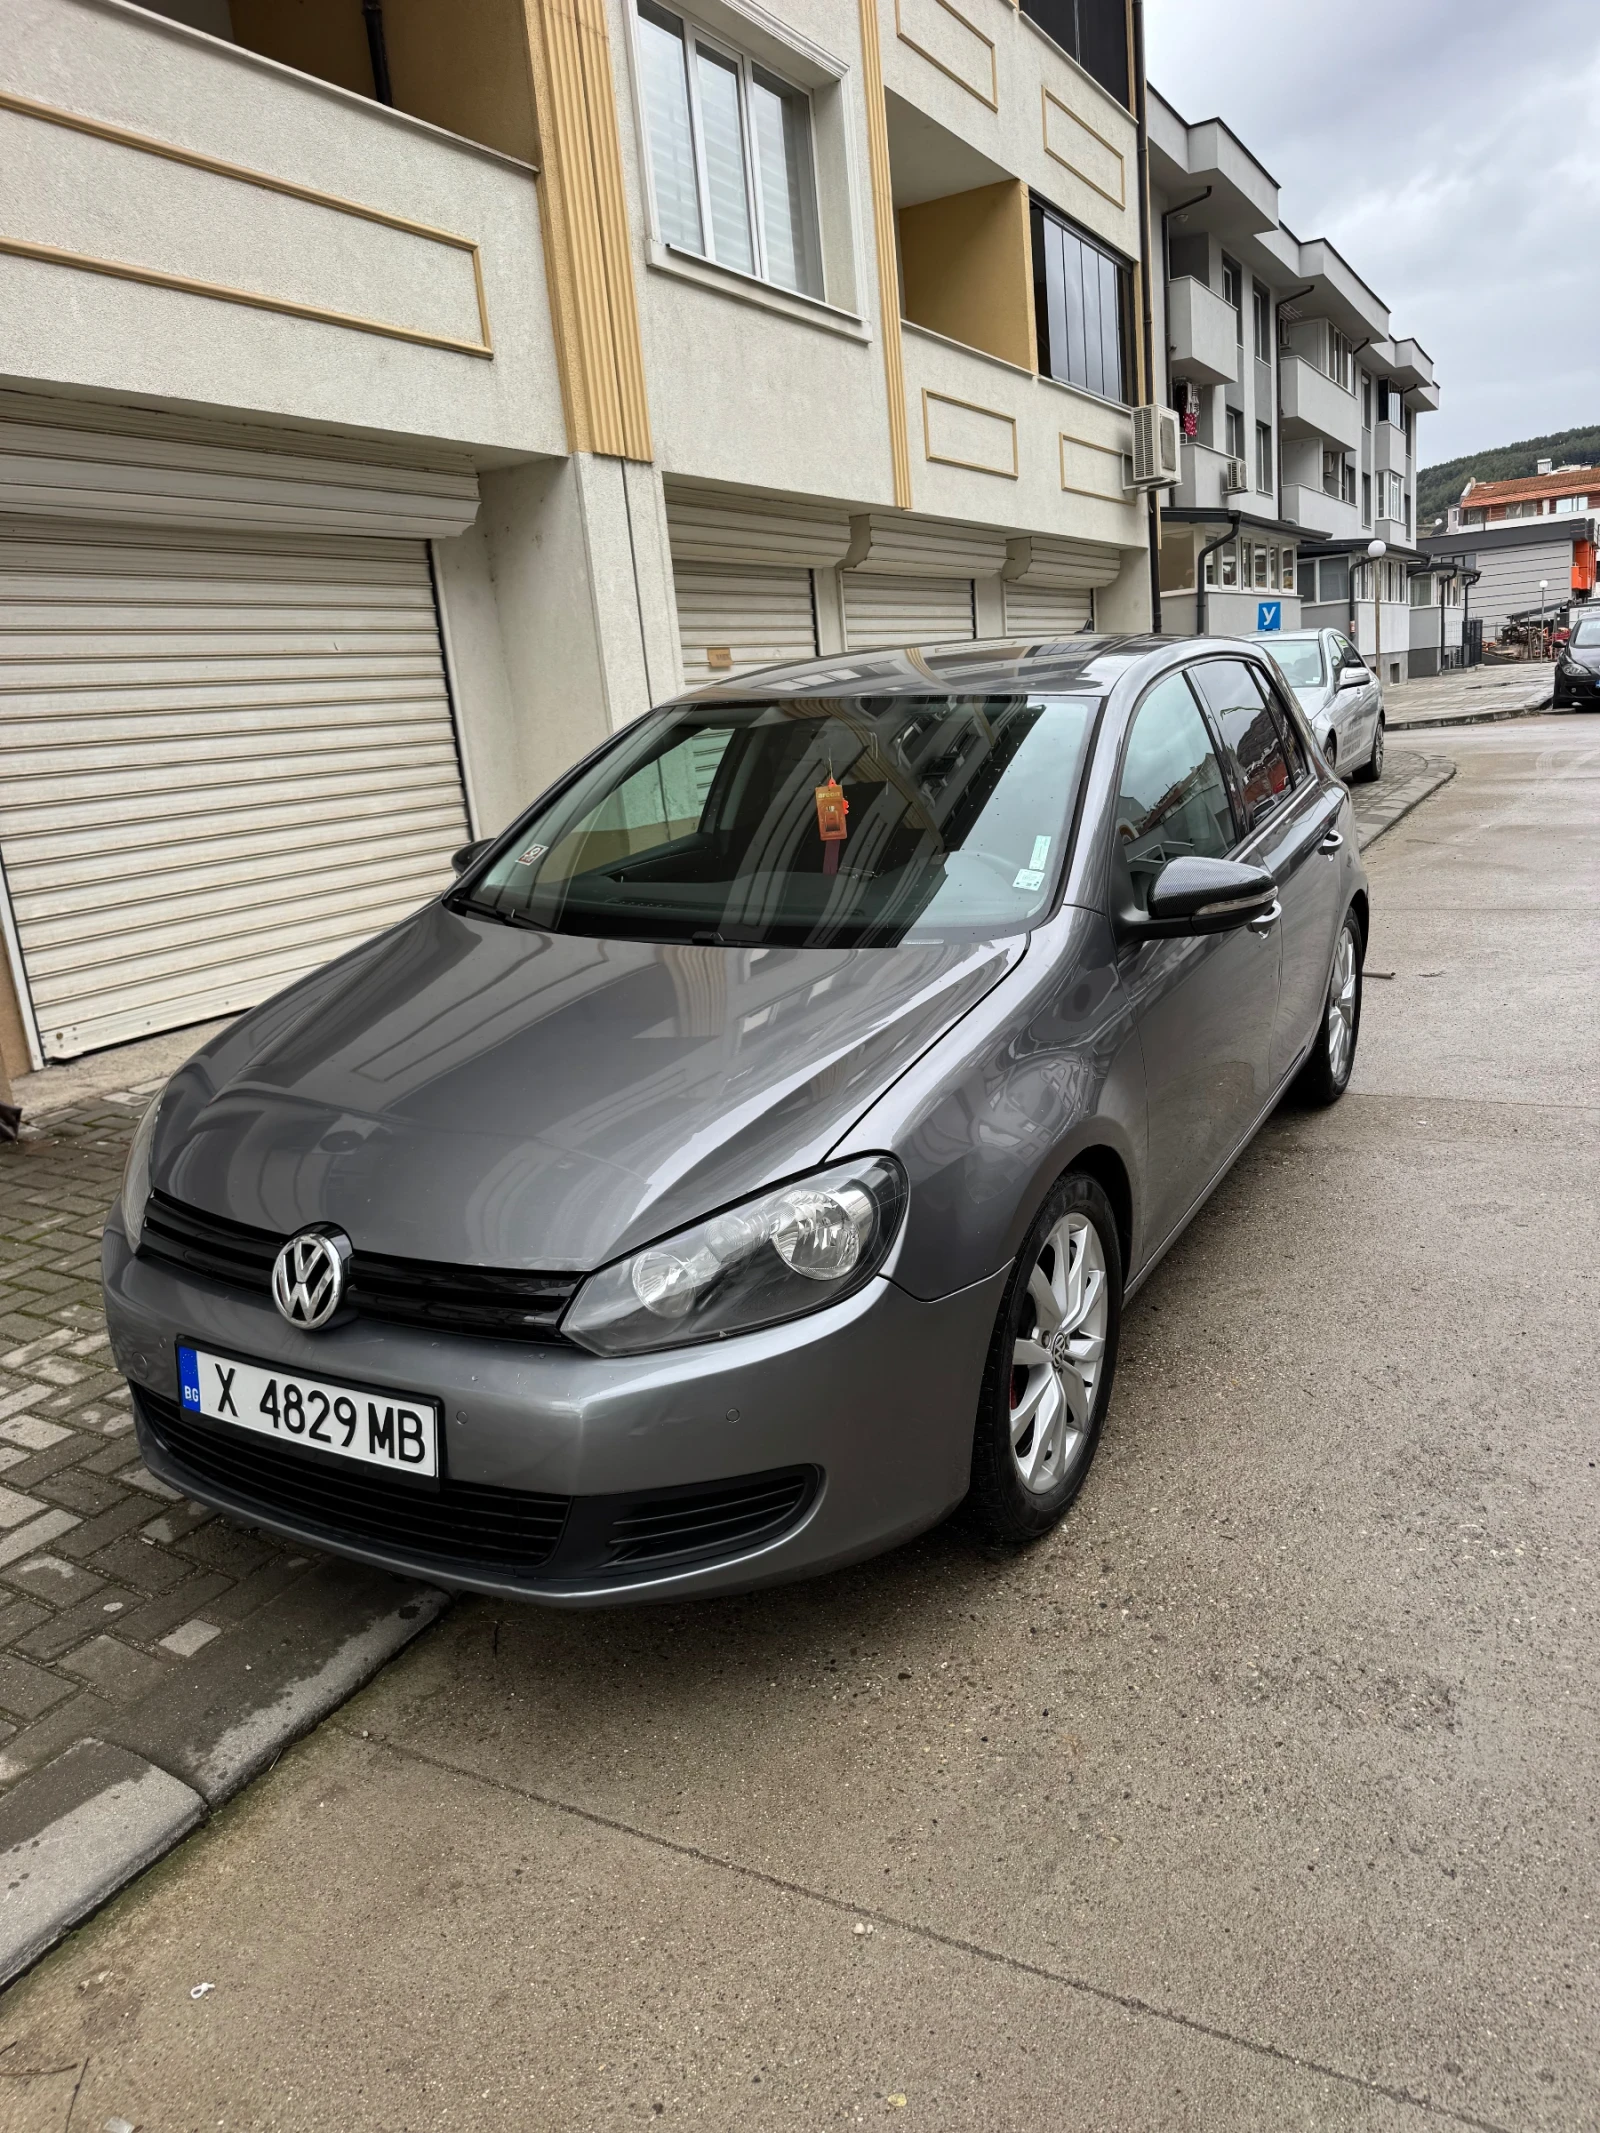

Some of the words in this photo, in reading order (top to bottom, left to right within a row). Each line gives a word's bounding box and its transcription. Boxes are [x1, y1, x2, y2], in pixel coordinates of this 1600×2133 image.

[184, 1385, 199, 1403] BG
[214, 1362, 239, 1418] X
[259, 1378, 357, 1448] 4829
[367, 1401, 426, 1464] MB
